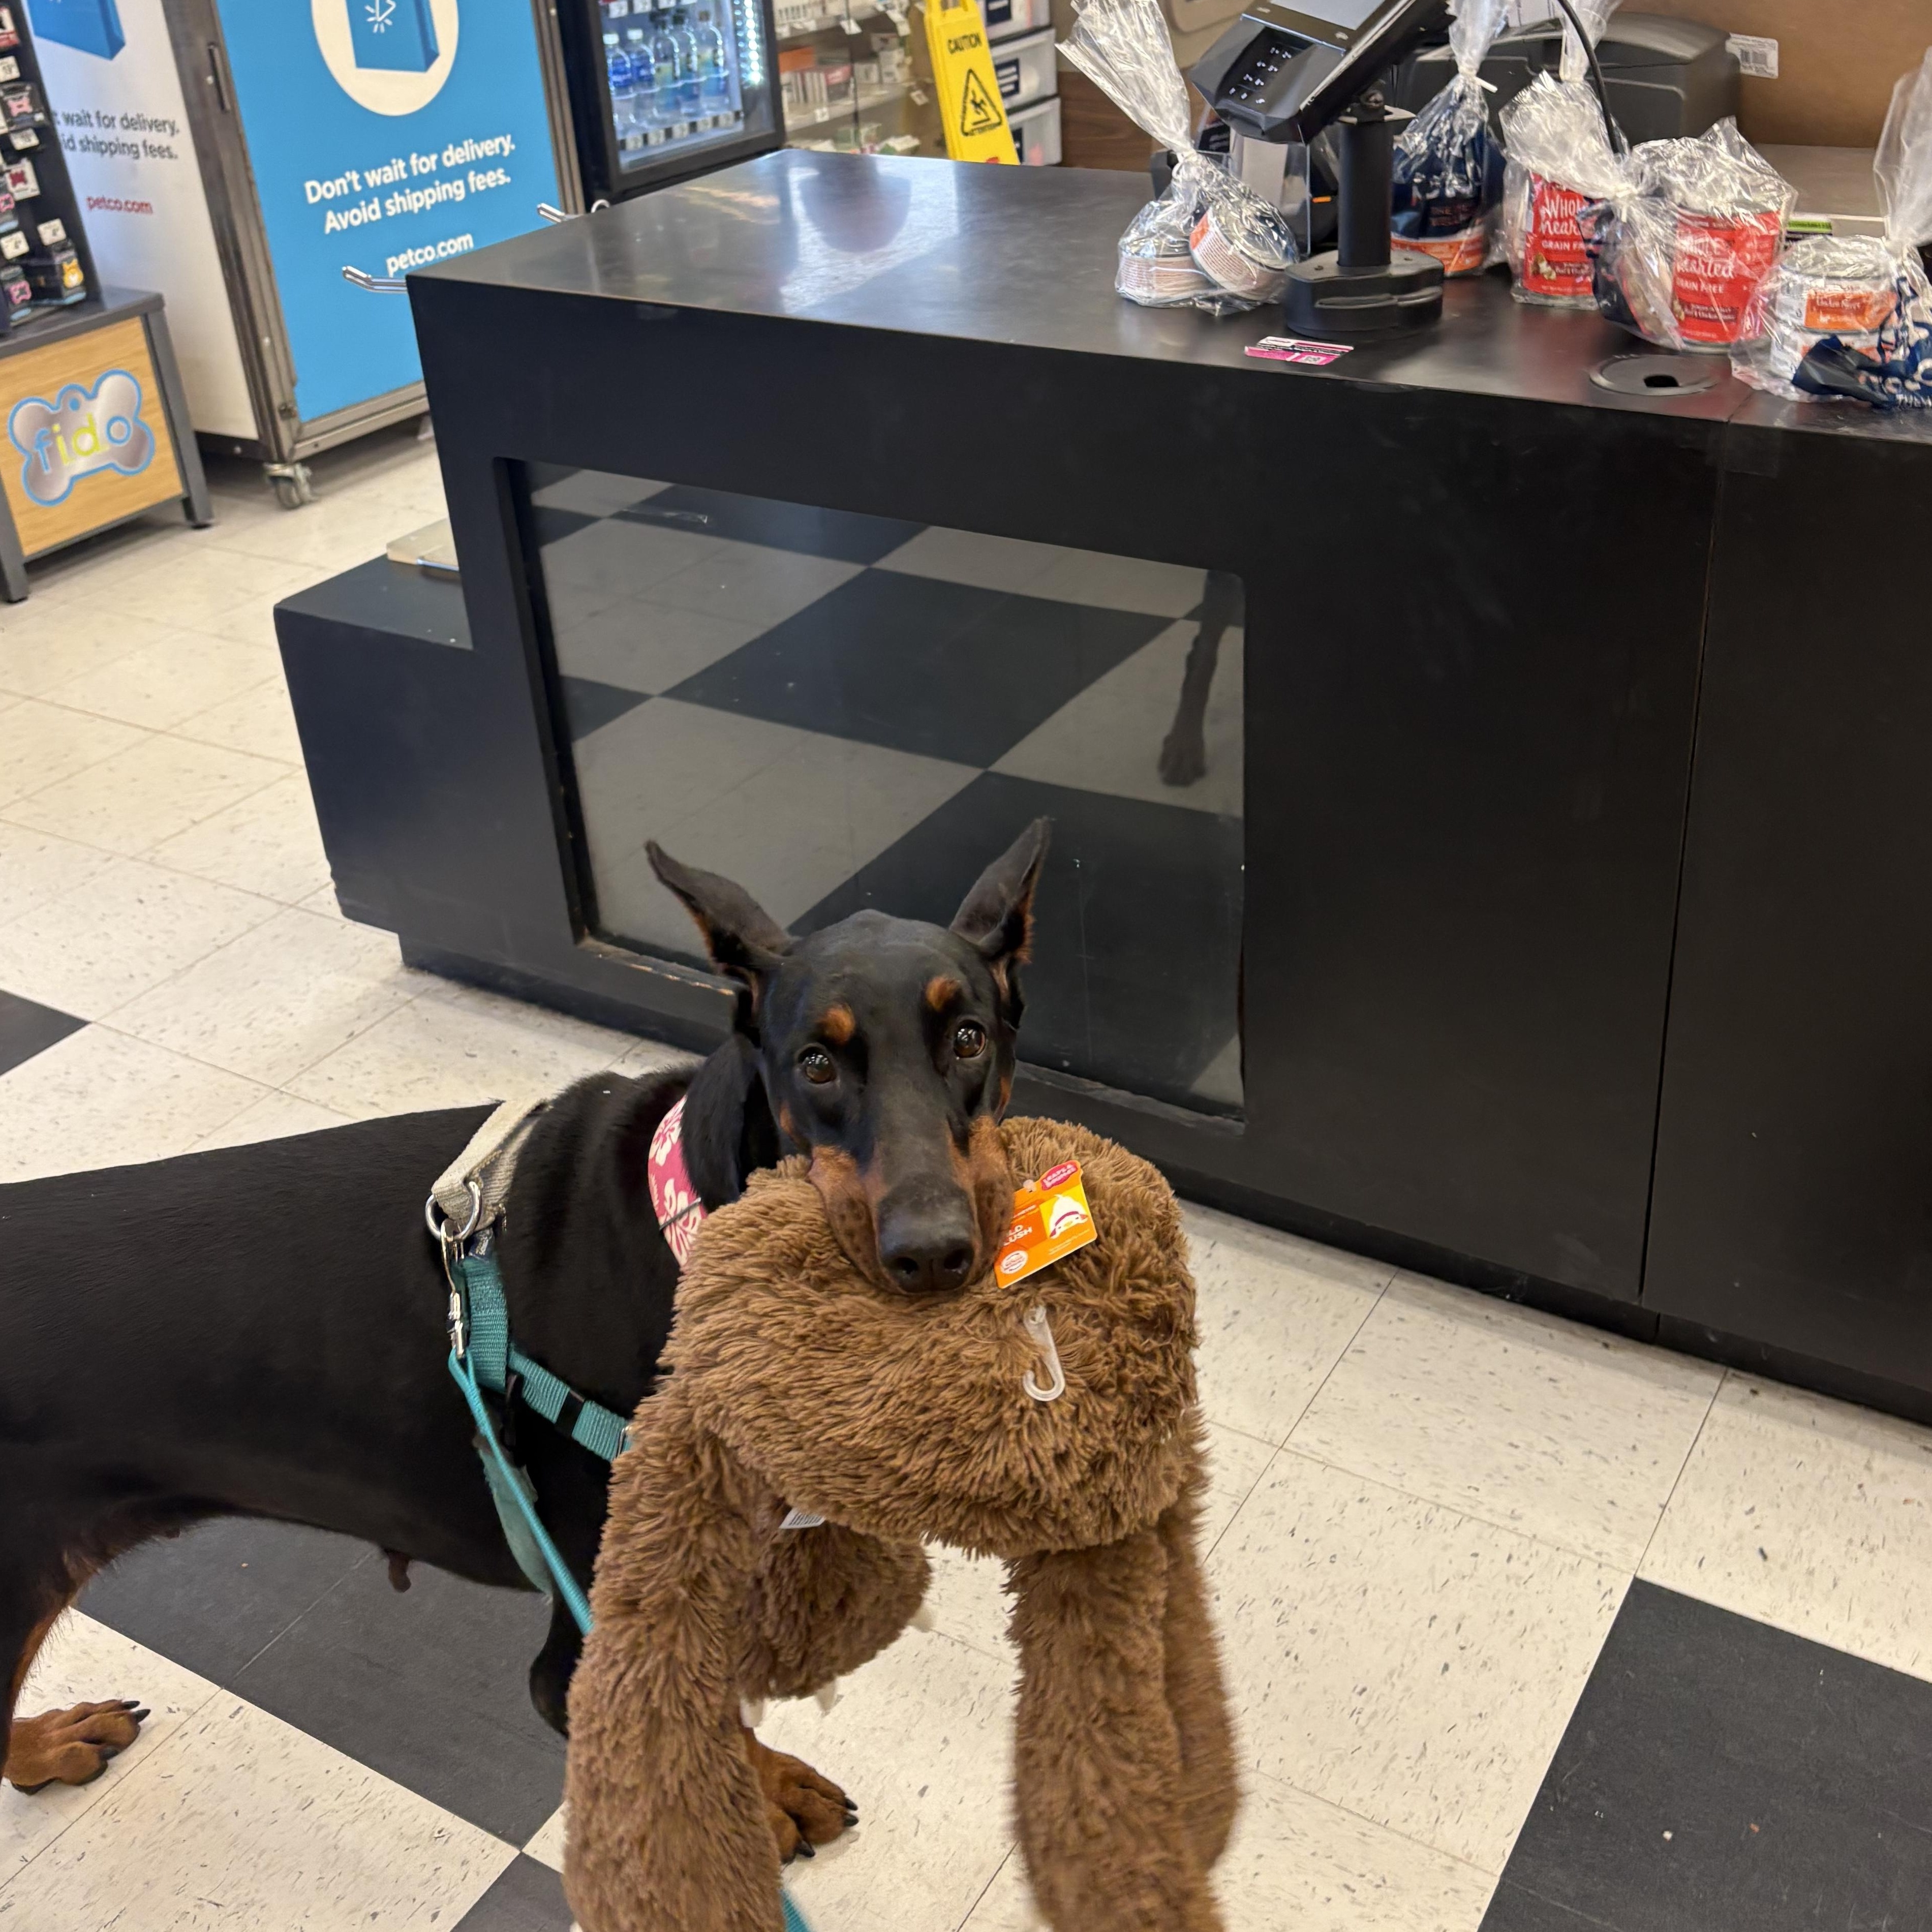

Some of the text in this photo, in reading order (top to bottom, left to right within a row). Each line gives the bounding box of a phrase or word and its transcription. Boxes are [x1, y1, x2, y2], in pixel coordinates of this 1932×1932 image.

[947, 34, 982, 54] CAUTION
[62, 109, 93, 127] wait
[96, 110, 116, 129] for
[120, 112, 180, 137] delivery.
[79, 134, 140, 160] shipping
[142, 139, 178, 160] fees.
[304, 134, 515, 204] Don't wait for delivery.
[86, 195, 153, 215] petco.com
[324, 168, 511, 234] Avoid shipping fees.
[386, 233, 474, 278] petco.com
[1541, 239, 1571, 251] GRAIN
[34, 413, 132, 473] fido
